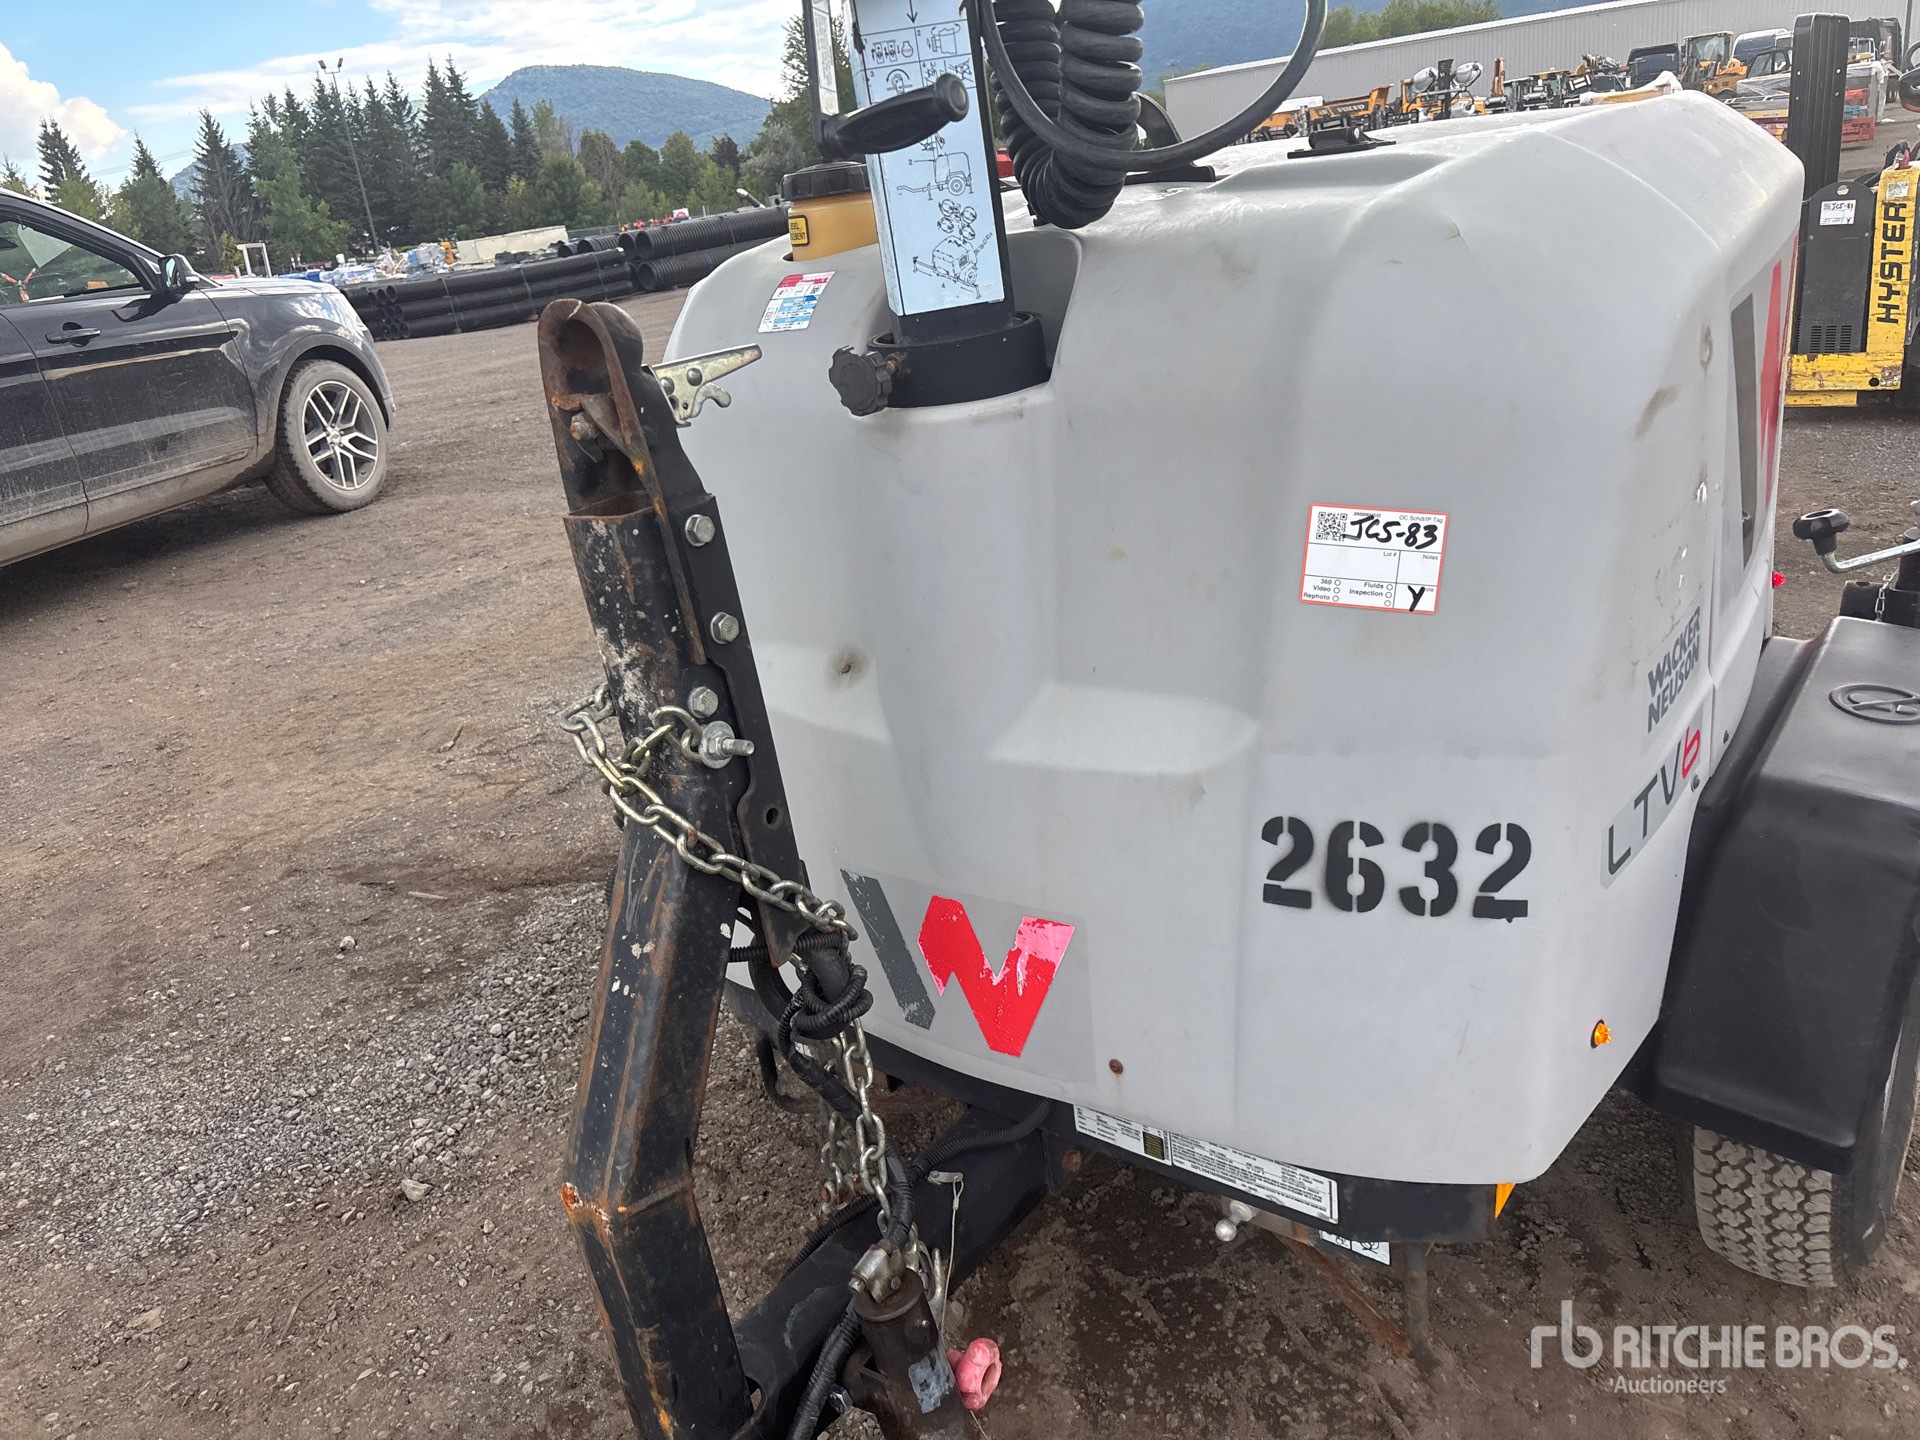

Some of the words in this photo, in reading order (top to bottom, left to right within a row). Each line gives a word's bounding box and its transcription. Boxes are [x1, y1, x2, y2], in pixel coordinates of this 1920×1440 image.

[1336, 103, 1366, 113] VOLVO
[1876, 202, 1908, 325] HYSTER
[1433, 516, 1444, 524] Tag
[1313, 584, 1331, 592] Video
[1363, 581, 1384, 589] Fluids
[1303, 591, 1331, 600] Rephoto
[1348, 588, 1384, 598] Inspection
[1648, 606, 1700, 697] WACKER
[1648, 634, 1700, 734] NEUSON
[1261, 815, 1532, 922] 2632
